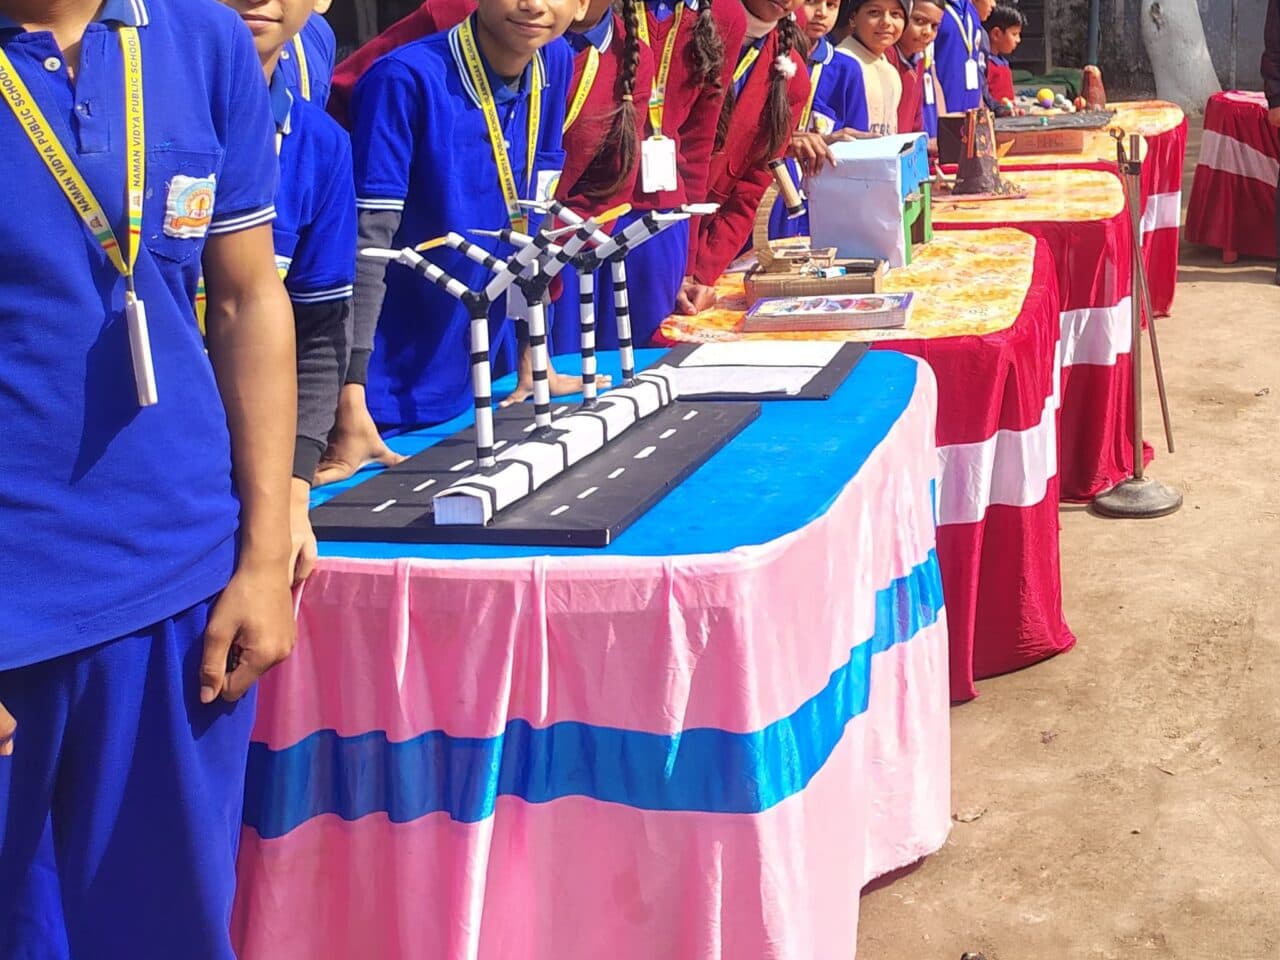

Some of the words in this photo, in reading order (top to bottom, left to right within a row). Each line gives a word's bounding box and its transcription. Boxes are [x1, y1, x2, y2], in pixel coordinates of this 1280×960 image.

[128, 34, 139, 73] SCHOOL
[131, 78, 140, 113] PUBLIC
[20, 108, 49, 146] PUBLIC
[132, 116, 140, 146] VIDYA
[44, 145, 68, 180] VIDYA
[132, 150, 141, 187] NAMAN
[64, 175, 92, 213] NAMAN
